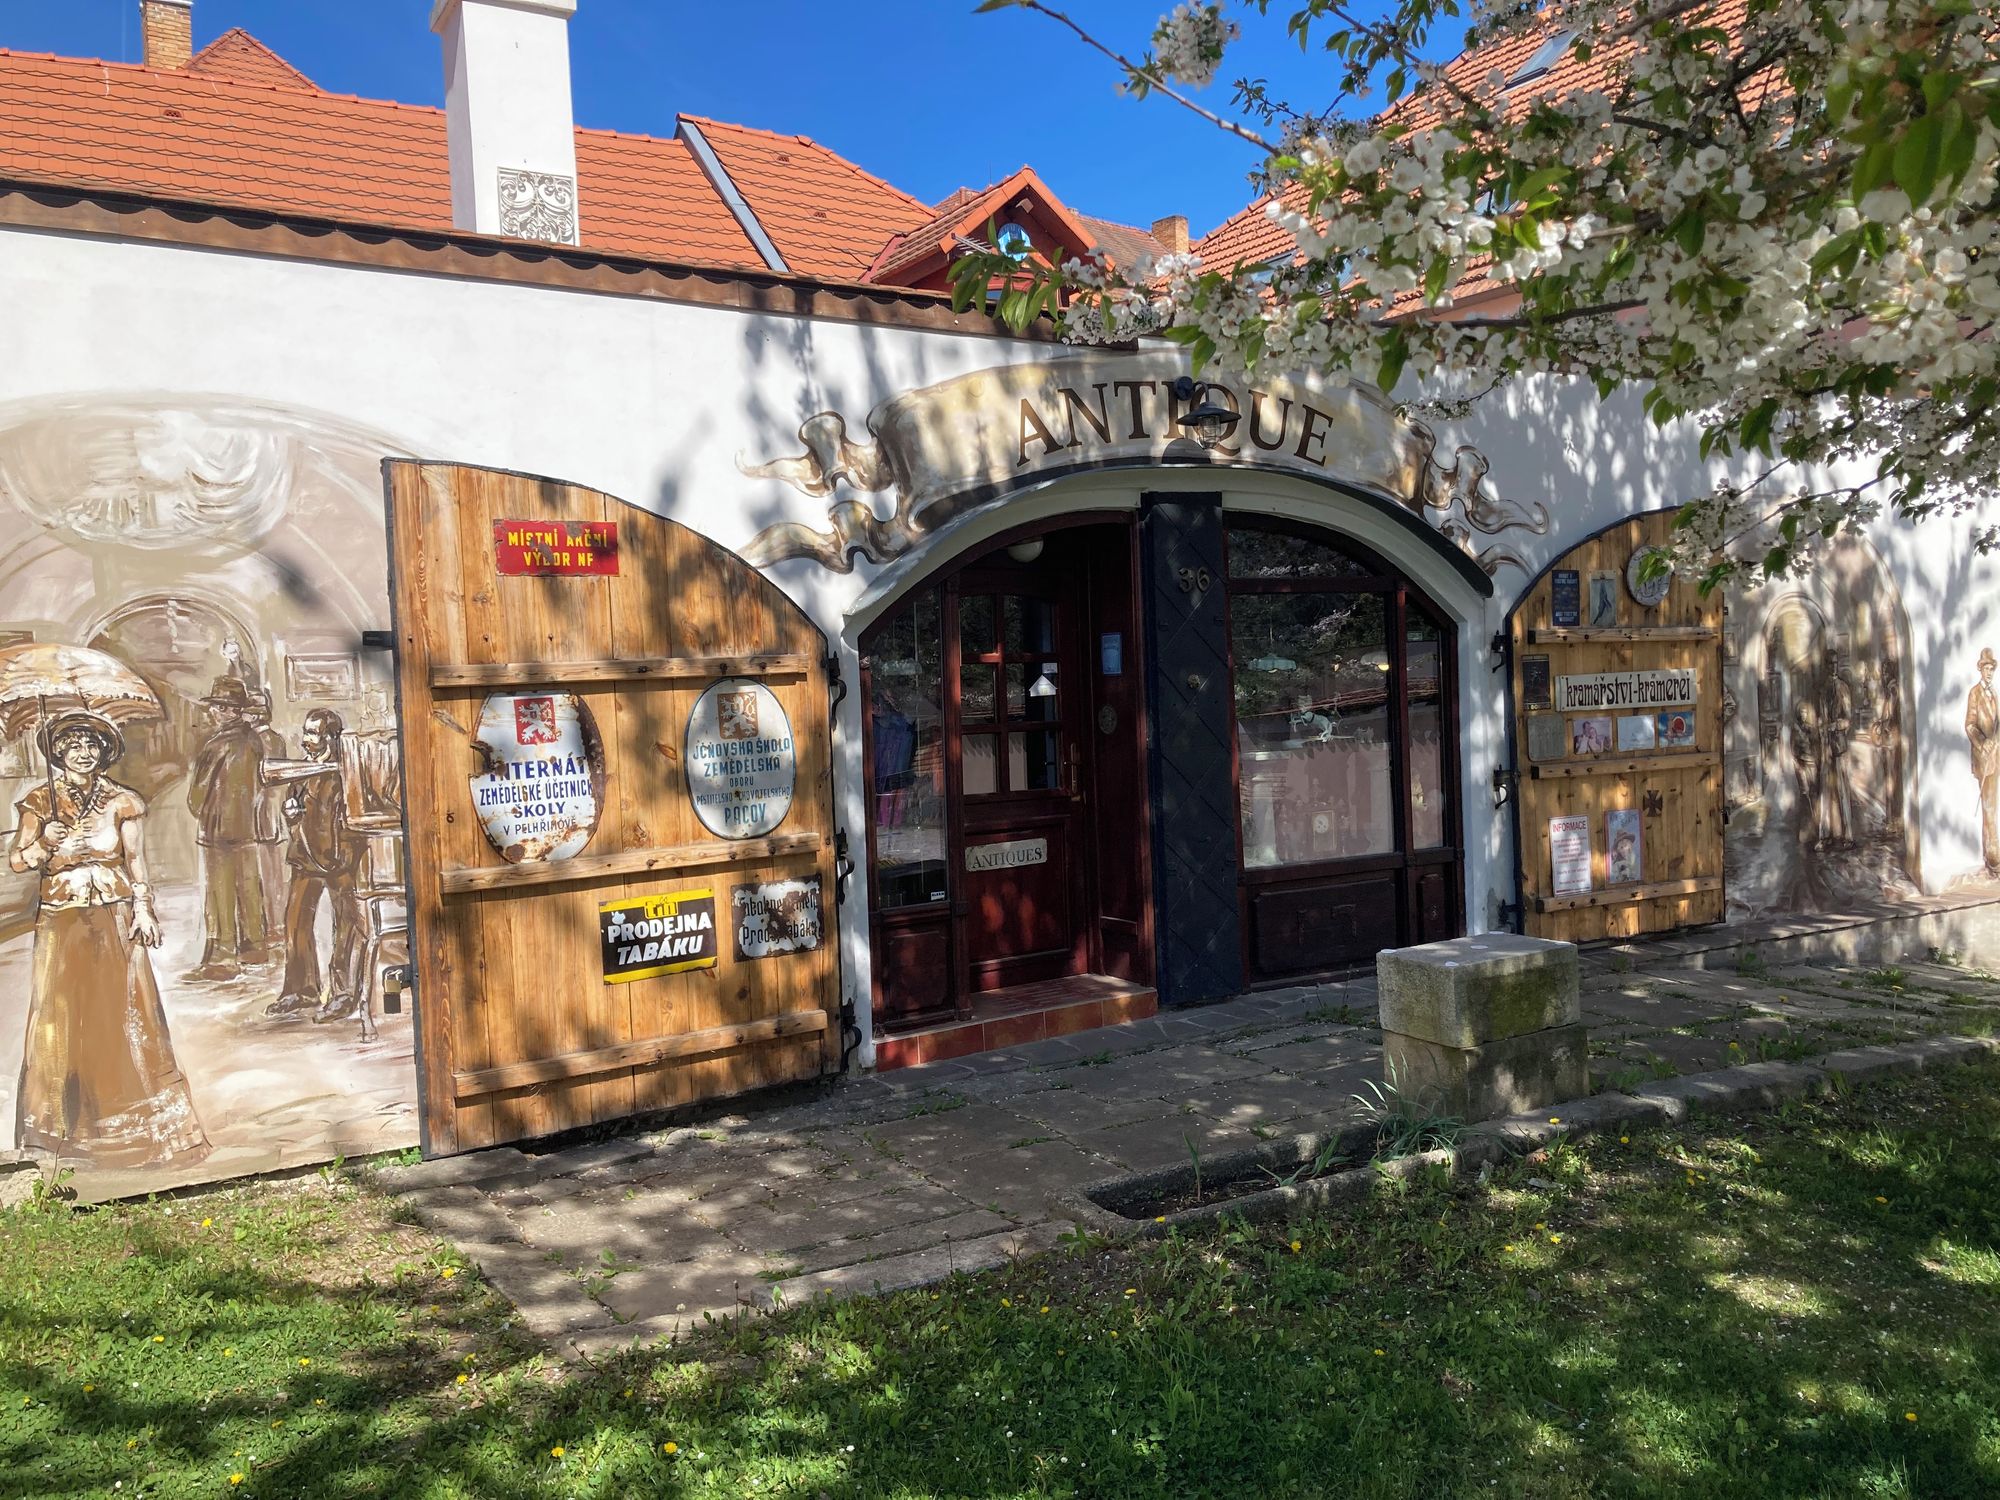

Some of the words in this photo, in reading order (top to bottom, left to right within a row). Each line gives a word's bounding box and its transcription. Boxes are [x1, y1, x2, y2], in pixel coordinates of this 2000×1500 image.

[1016, 380, 1334, 467] ANTIQUE
[508, 528, 559, 547] MÍSTNÍ
[1178, 566, 1210, 593] 36
[479, 781, 542, 806] ZEMĚDĚLSKÉ
[545, 777, 593, 801] ÚČETNICK
[729, 776, 754, 788] OBORU
[514, 801, 566, 819] ŠKOLY
[724, 803, 766, 826] PACOV
[503, 825, 510, 837] V
[1552, 820, 1587, 833] INFORMACE
[973, 847, 1042, 868] ANTIQUES
[607, 911, 713, 944] PRODEJNA
[617, 934, 704, 966] TABÁKU
